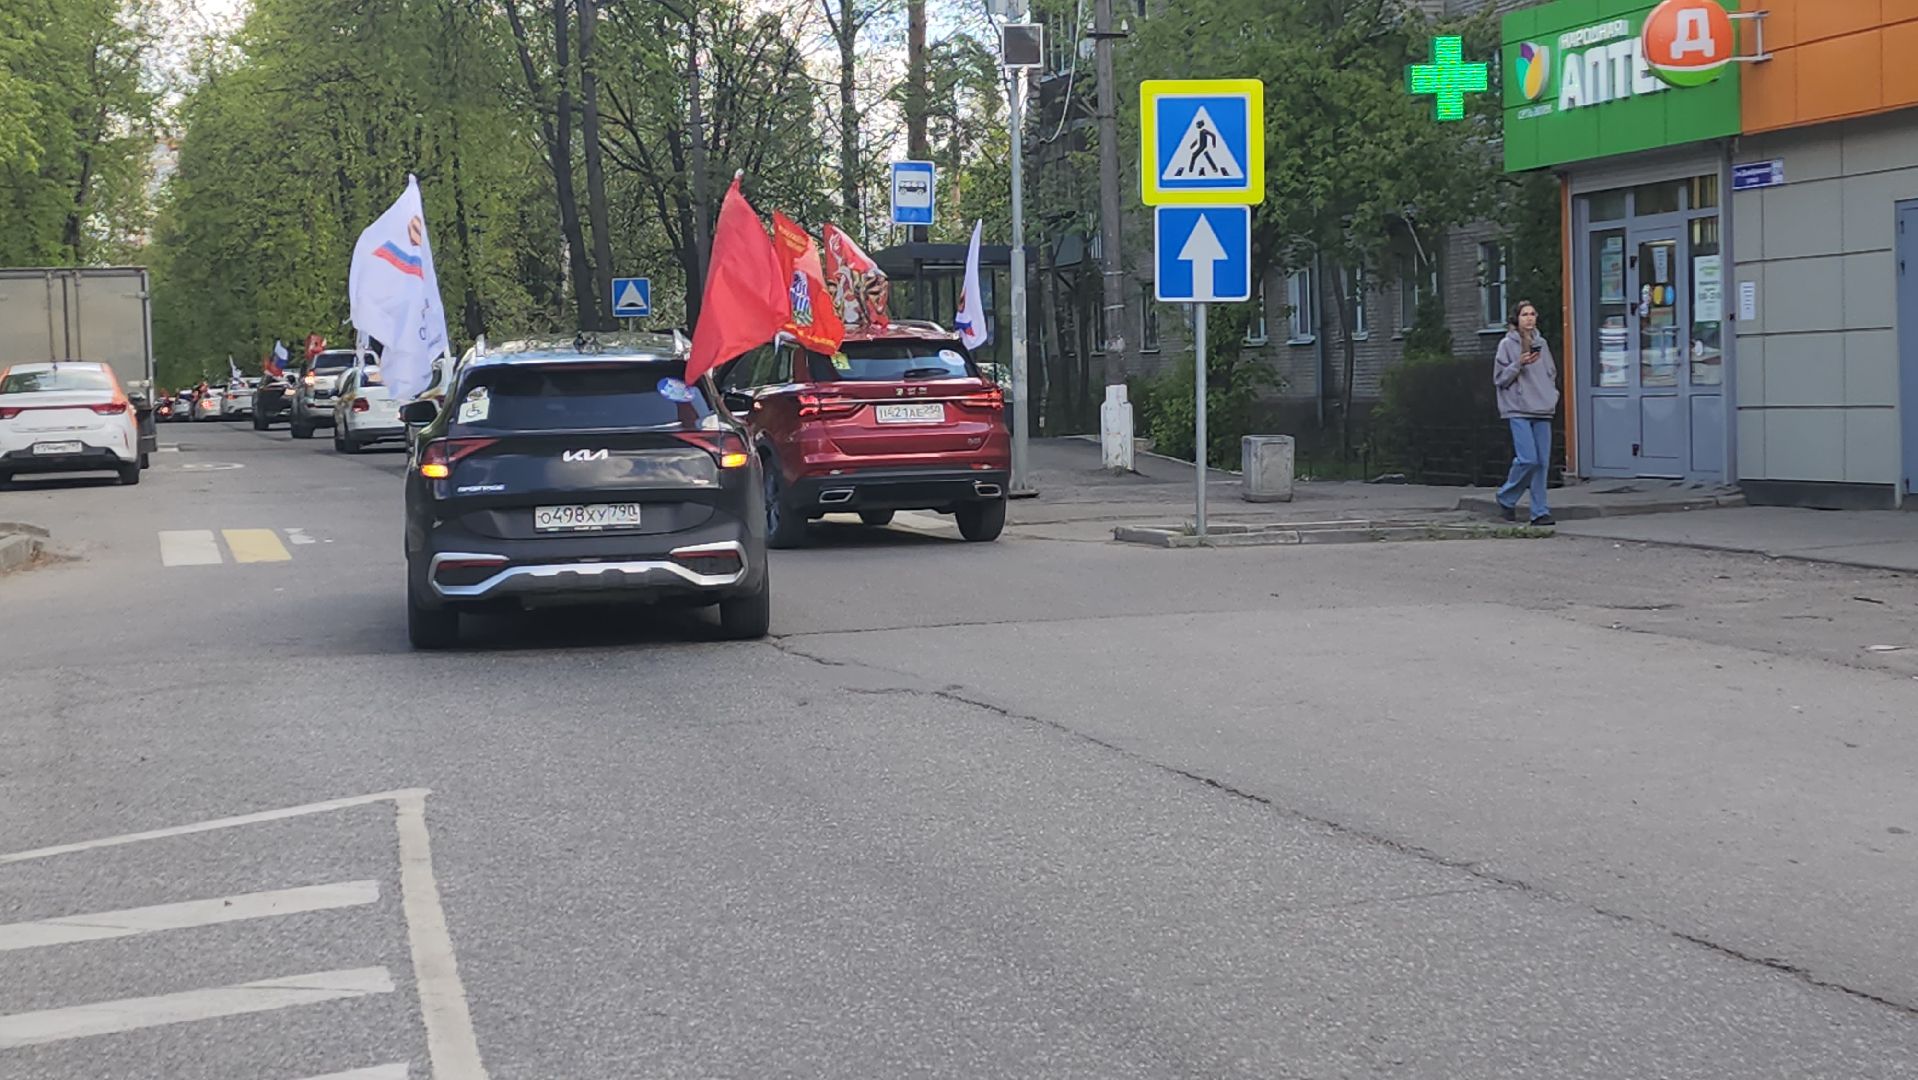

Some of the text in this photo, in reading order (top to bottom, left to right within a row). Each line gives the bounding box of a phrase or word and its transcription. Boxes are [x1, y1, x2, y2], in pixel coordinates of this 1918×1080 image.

[1670, 7, 1715, 59] Д
[1558, 37, 1671, 111] АПТЕ
[562, 448, 609, 462] KIA
